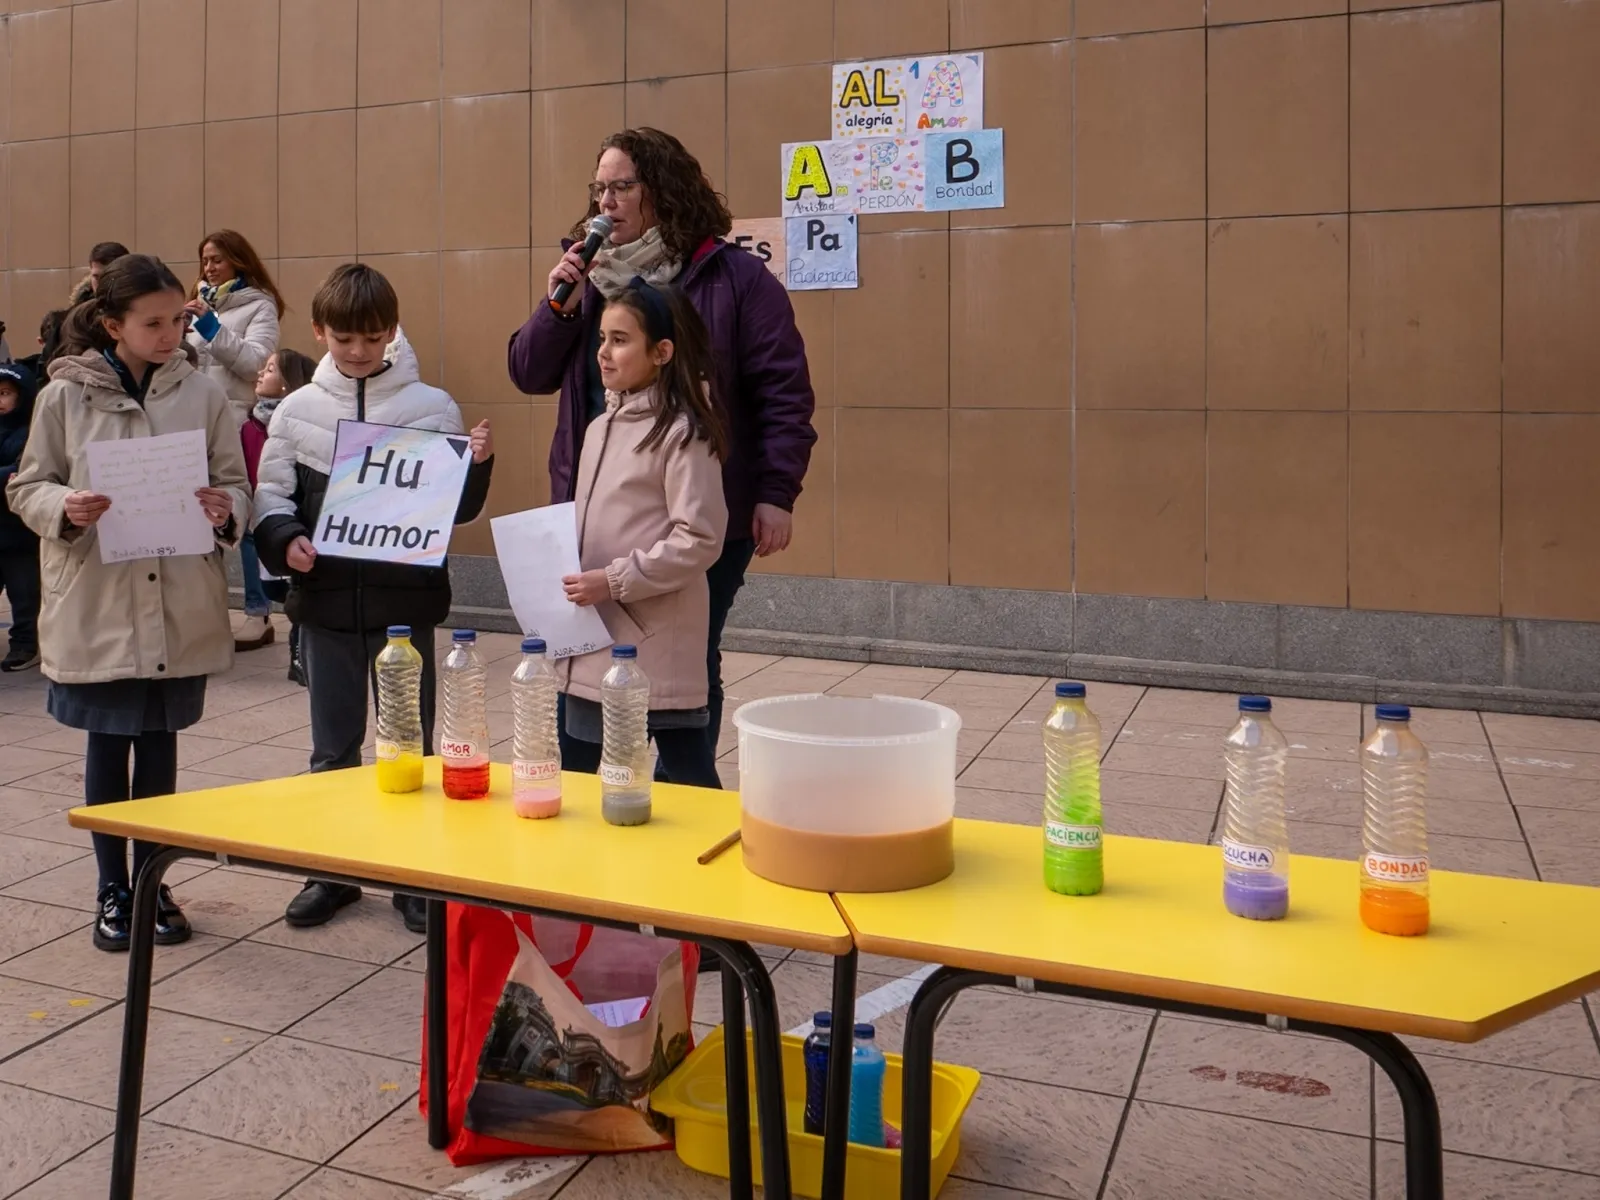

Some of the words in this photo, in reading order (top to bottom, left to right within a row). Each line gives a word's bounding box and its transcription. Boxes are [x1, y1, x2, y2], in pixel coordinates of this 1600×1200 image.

[839, 68, 900, 109] AL
[922, 60, 964, 109] A
[845, 112, 893, 129] alegría
[917, 112, 968, 129] Amor
[946, 138, 980, 184] B
[859, 190, 917, 209] PERDÓN
[935, 180, 995, 199] Bondad
[806, 219, 843, 251] Pa
[789, 257, 856, 284] Paciencia
[357, 445, 424, 489] Hu
[321, 514, 440, 551] Humor
[1367, 858, 1427, 874] BONDAD
